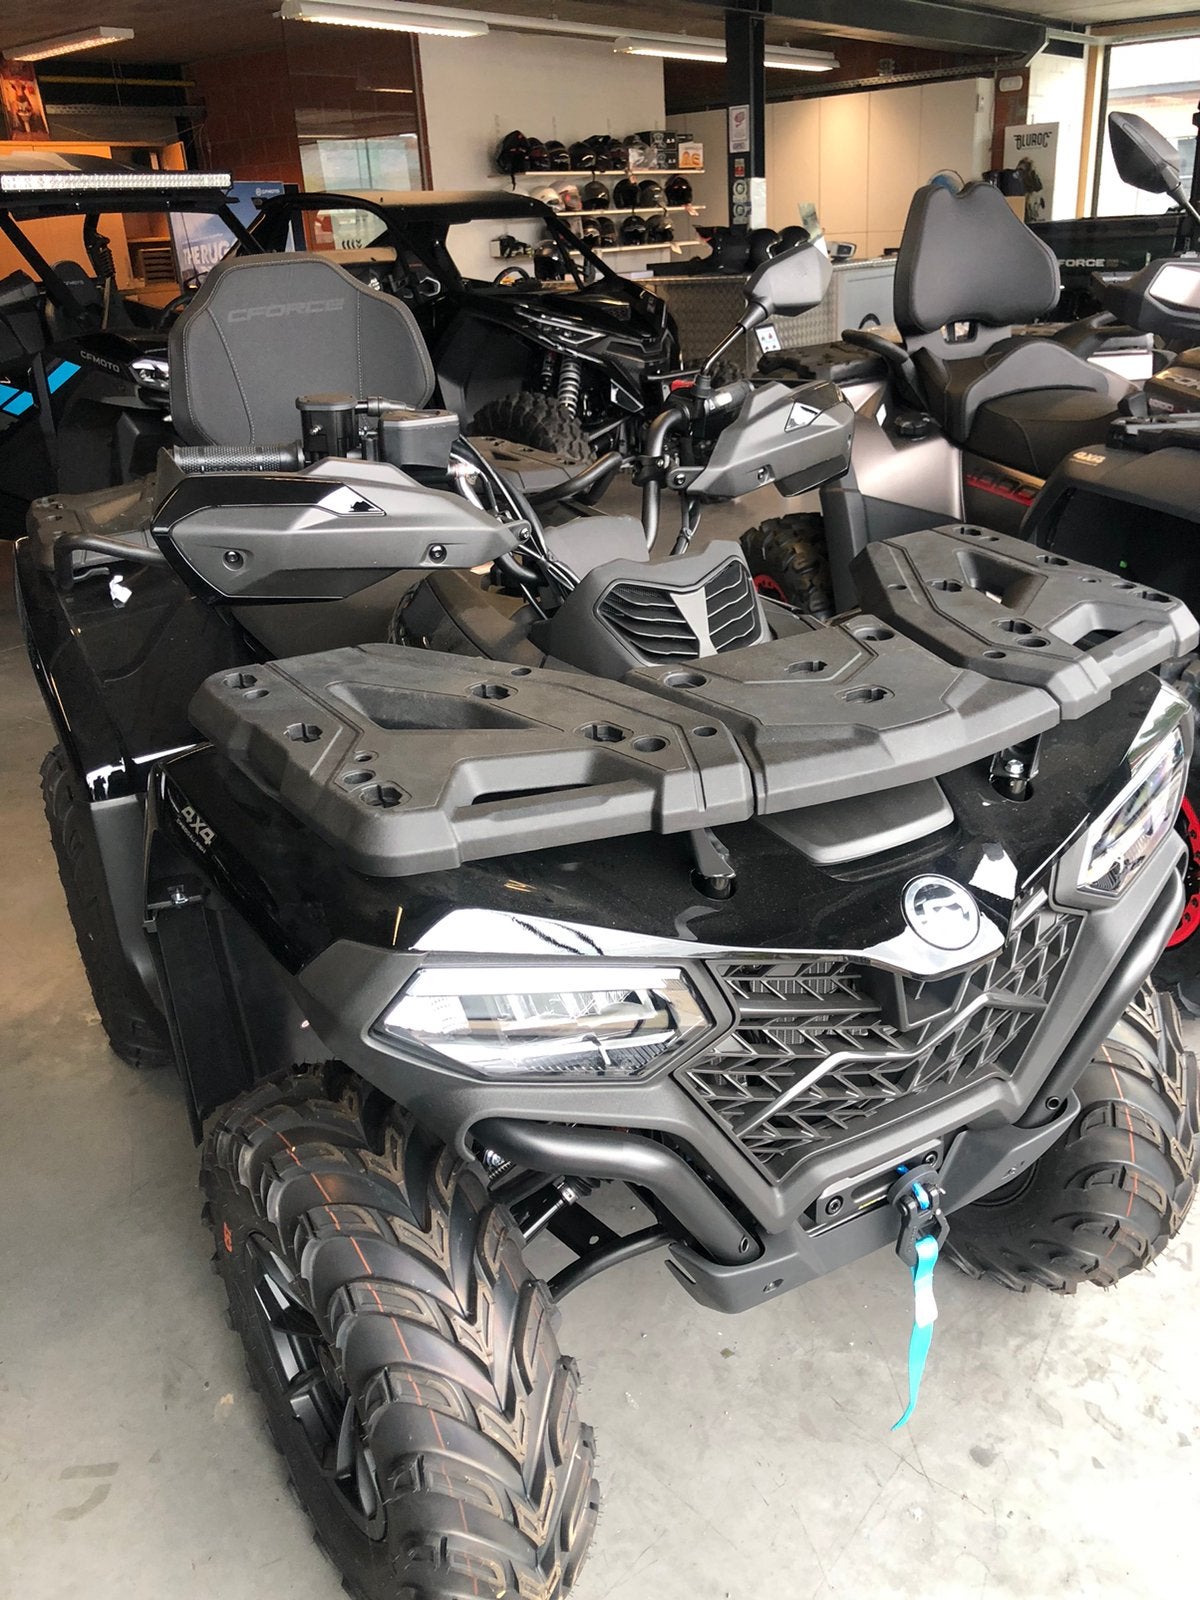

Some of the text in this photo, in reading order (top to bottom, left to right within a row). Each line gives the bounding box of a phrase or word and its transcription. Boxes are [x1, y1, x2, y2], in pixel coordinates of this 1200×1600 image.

[1013, 131, 1052, 150] BLUROC
[227, 298, 345, 323] CFORCE
[80, 350, 120, 373] CFMOTO
[180, 805, 216, 846] 4X4
